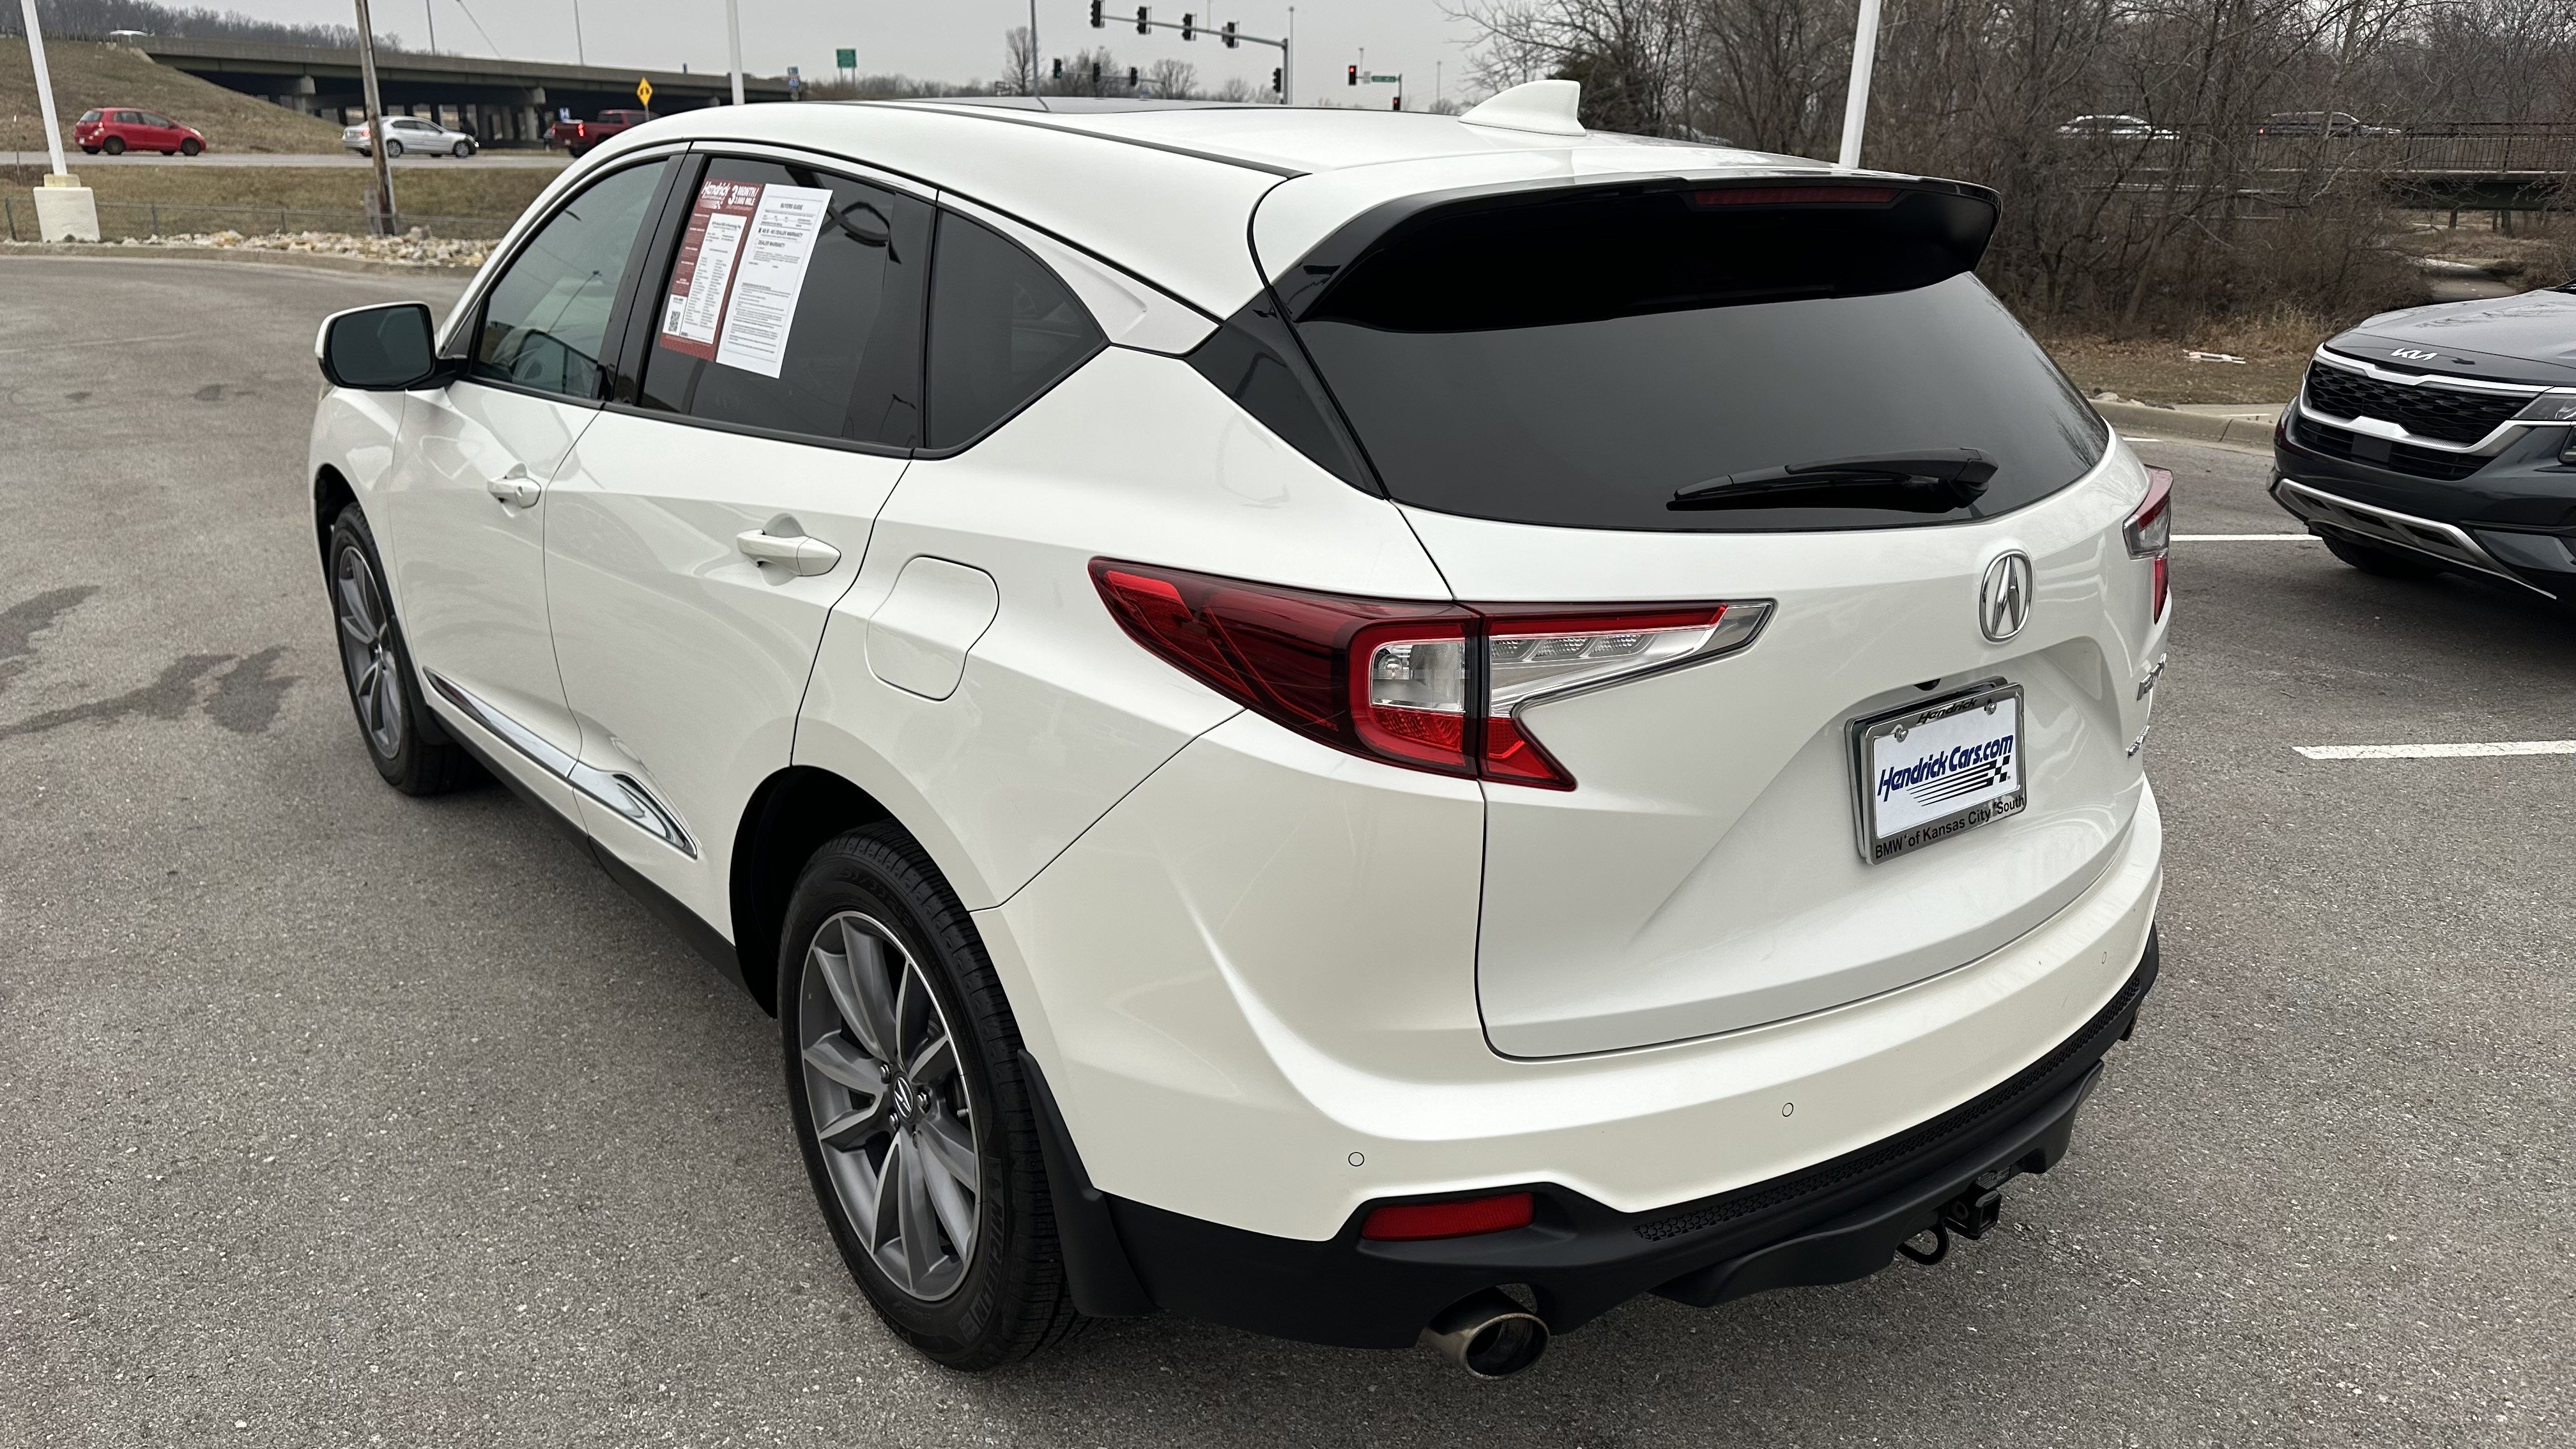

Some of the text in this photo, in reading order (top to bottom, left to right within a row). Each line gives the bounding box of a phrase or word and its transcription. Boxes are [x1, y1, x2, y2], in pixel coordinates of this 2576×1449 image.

[701, 181, 730, 199] Hendrick
[728, 185, 739, 205] 3
[744, 197, 756, 206] MILE
[1917, 698, 1977, 724] Hendrick
[1875, 794, 2024, 859] BMW of Kansas City South
[973, 1197, 1002, 1327] MICHELIN
